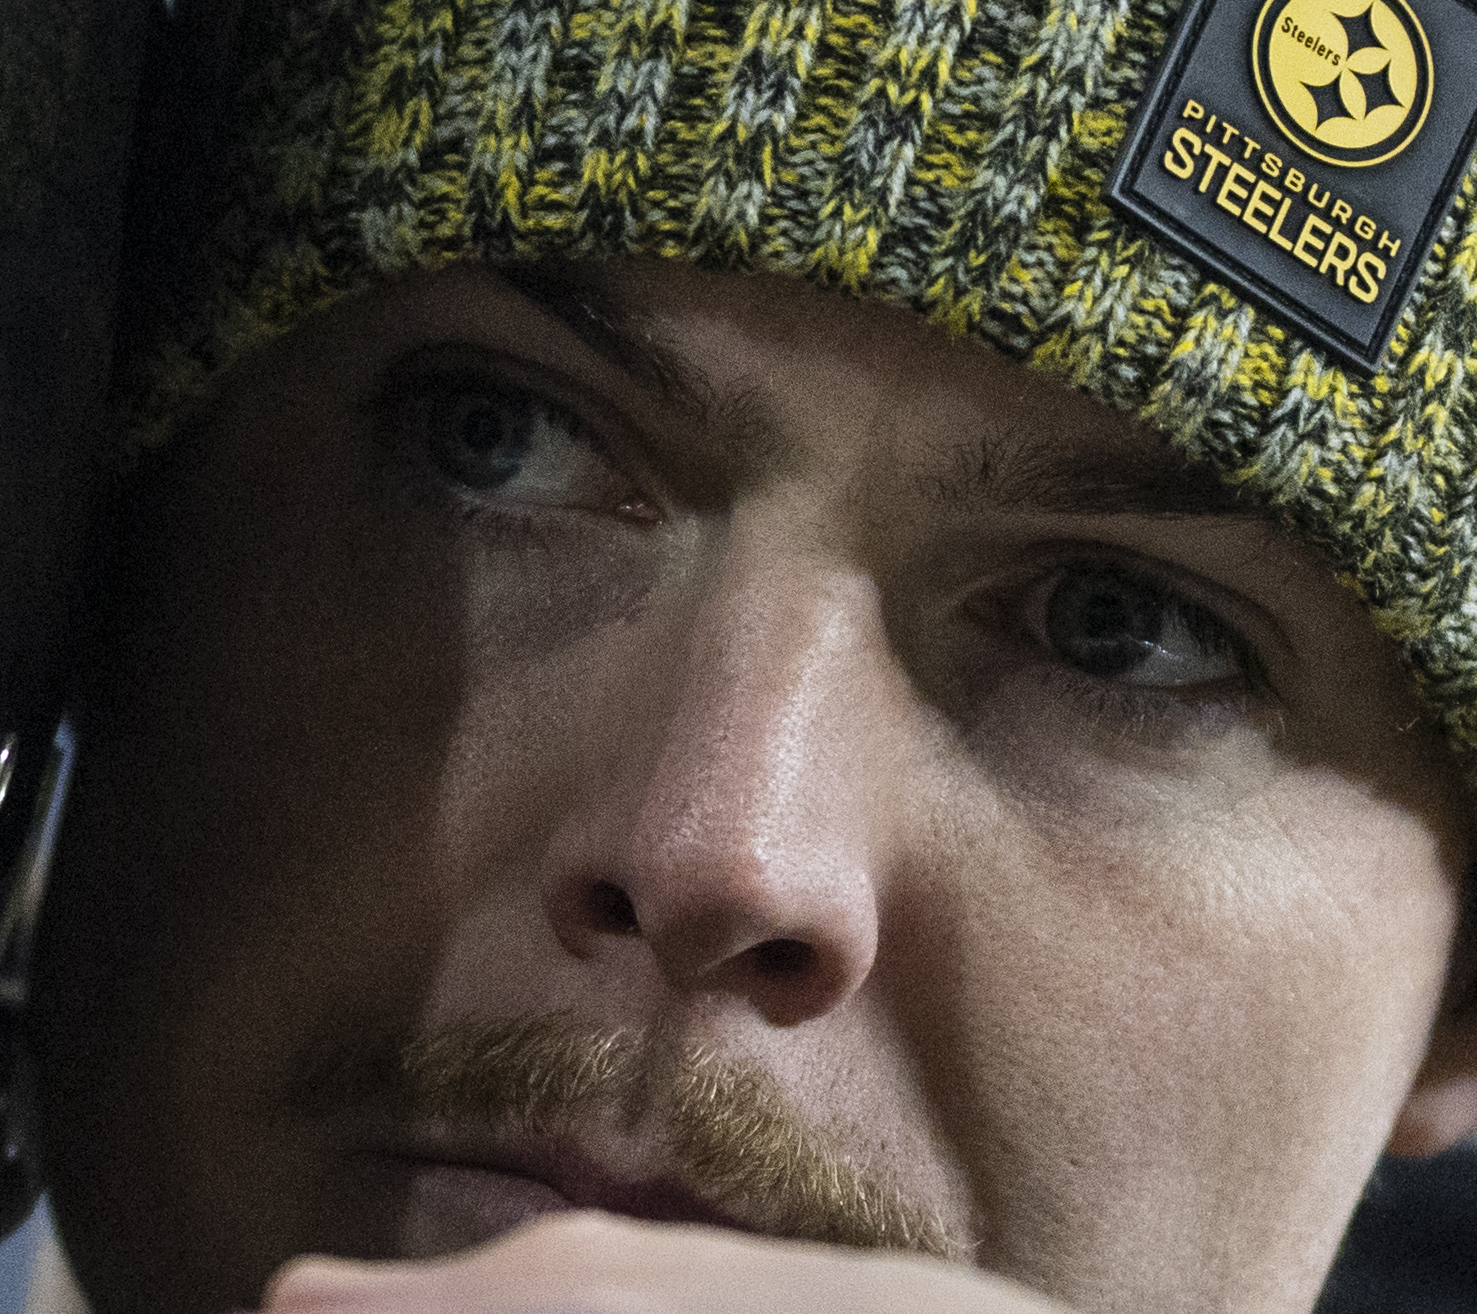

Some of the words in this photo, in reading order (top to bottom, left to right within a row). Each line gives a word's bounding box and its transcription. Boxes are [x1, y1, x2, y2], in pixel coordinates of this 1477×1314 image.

[1281, 16, 1341, 66] Steelers
[1163, 126, 1387, 305] STEELERS
[1182, 98, 1402, 258] PITTSBURGH
